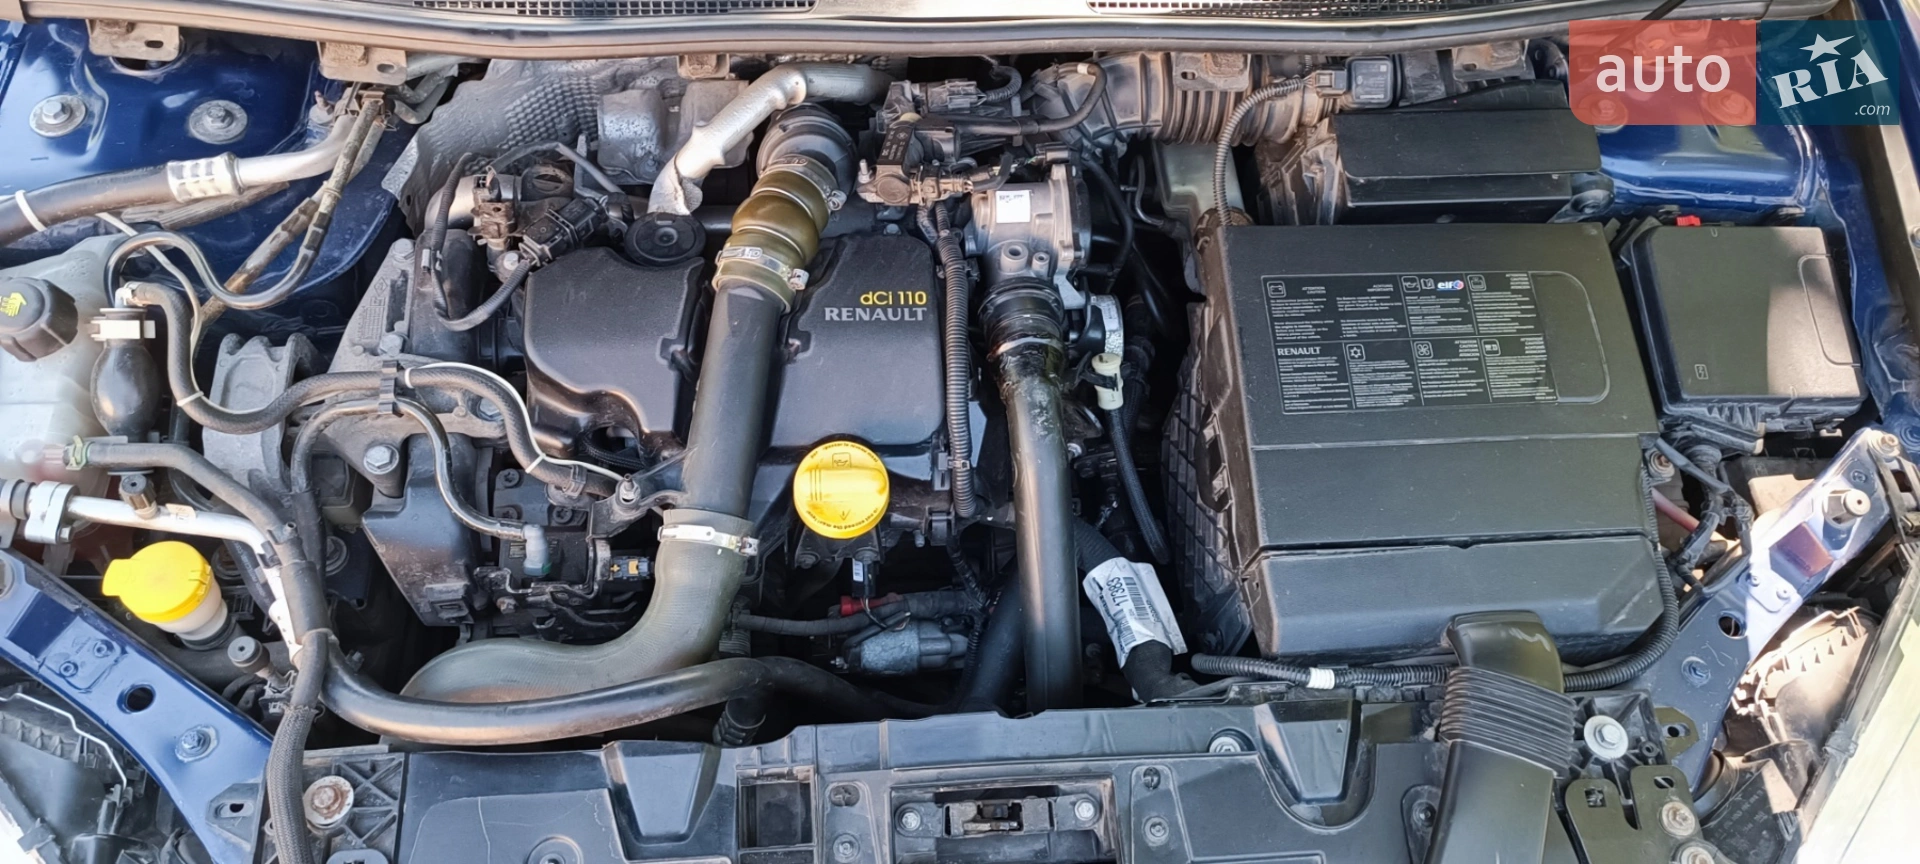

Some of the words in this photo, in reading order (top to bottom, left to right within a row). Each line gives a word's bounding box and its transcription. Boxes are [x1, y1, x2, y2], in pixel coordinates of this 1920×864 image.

[1437, 280, 1455, 290] elf
[860, 291, 893, 305] dCi
[897, 291, 927, 305] 110
[824, 307, 928, 321] RENAULT
[1277, 346, 1321, 356] RENAULT
[1106, 577, 1129, 607] 17383
